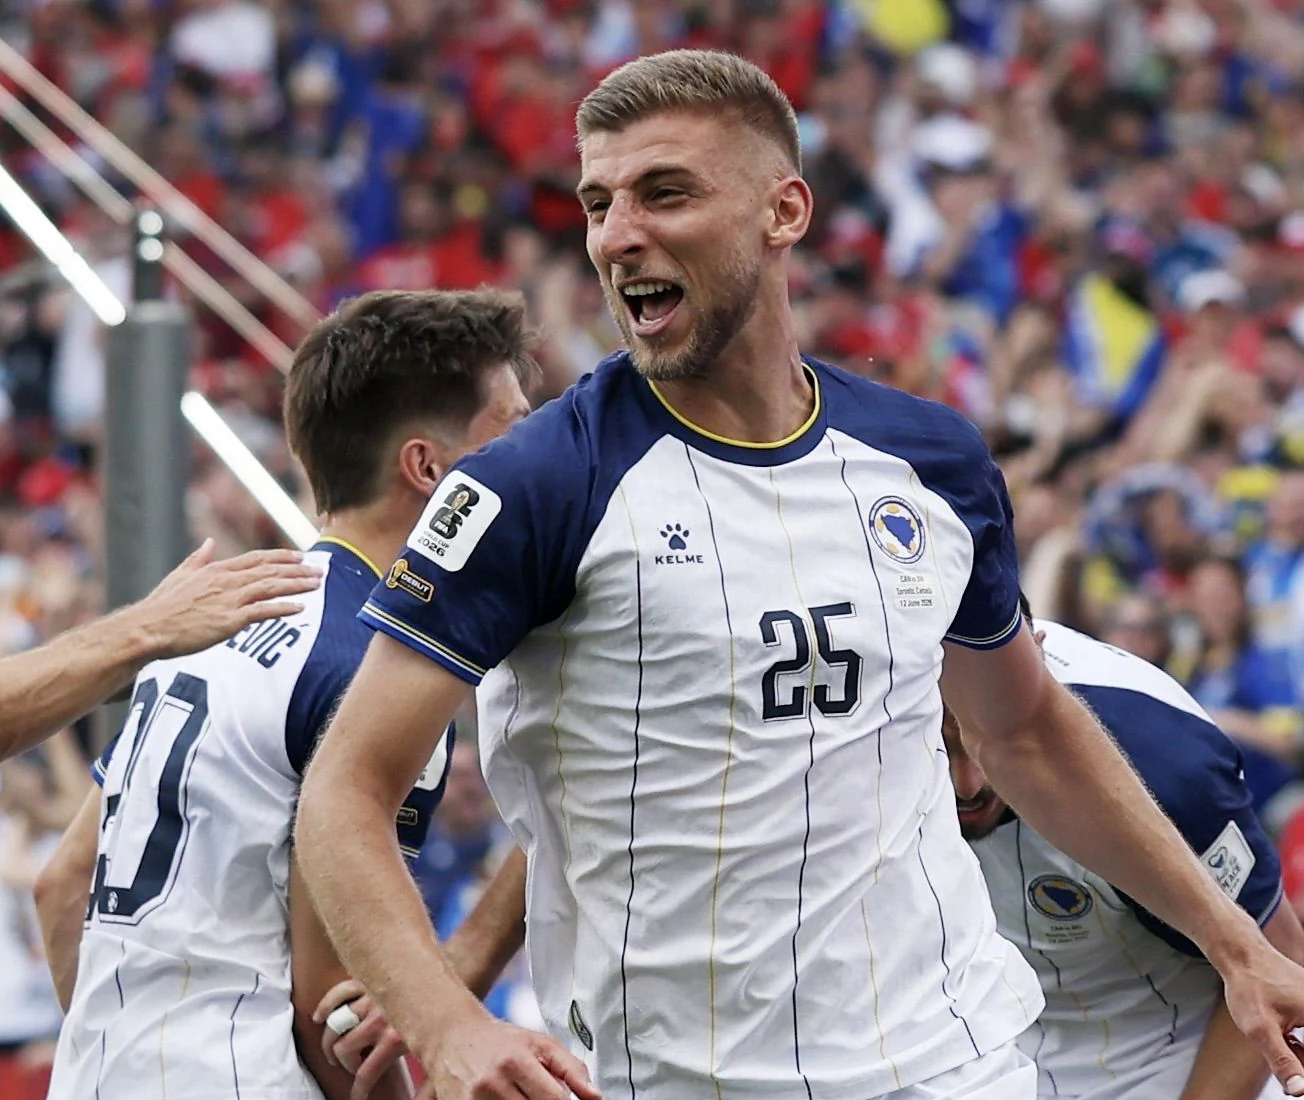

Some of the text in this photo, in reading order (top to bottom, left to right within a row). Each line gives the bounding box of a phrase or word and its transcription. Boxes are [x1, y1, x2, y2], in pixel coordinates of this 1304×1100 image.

[417, 536, 447, 557] 2026
[655, 554, 704, 565] KELME
[401, 572, 430, 593] DEBUT
[759, 602, 864, 722] 25
